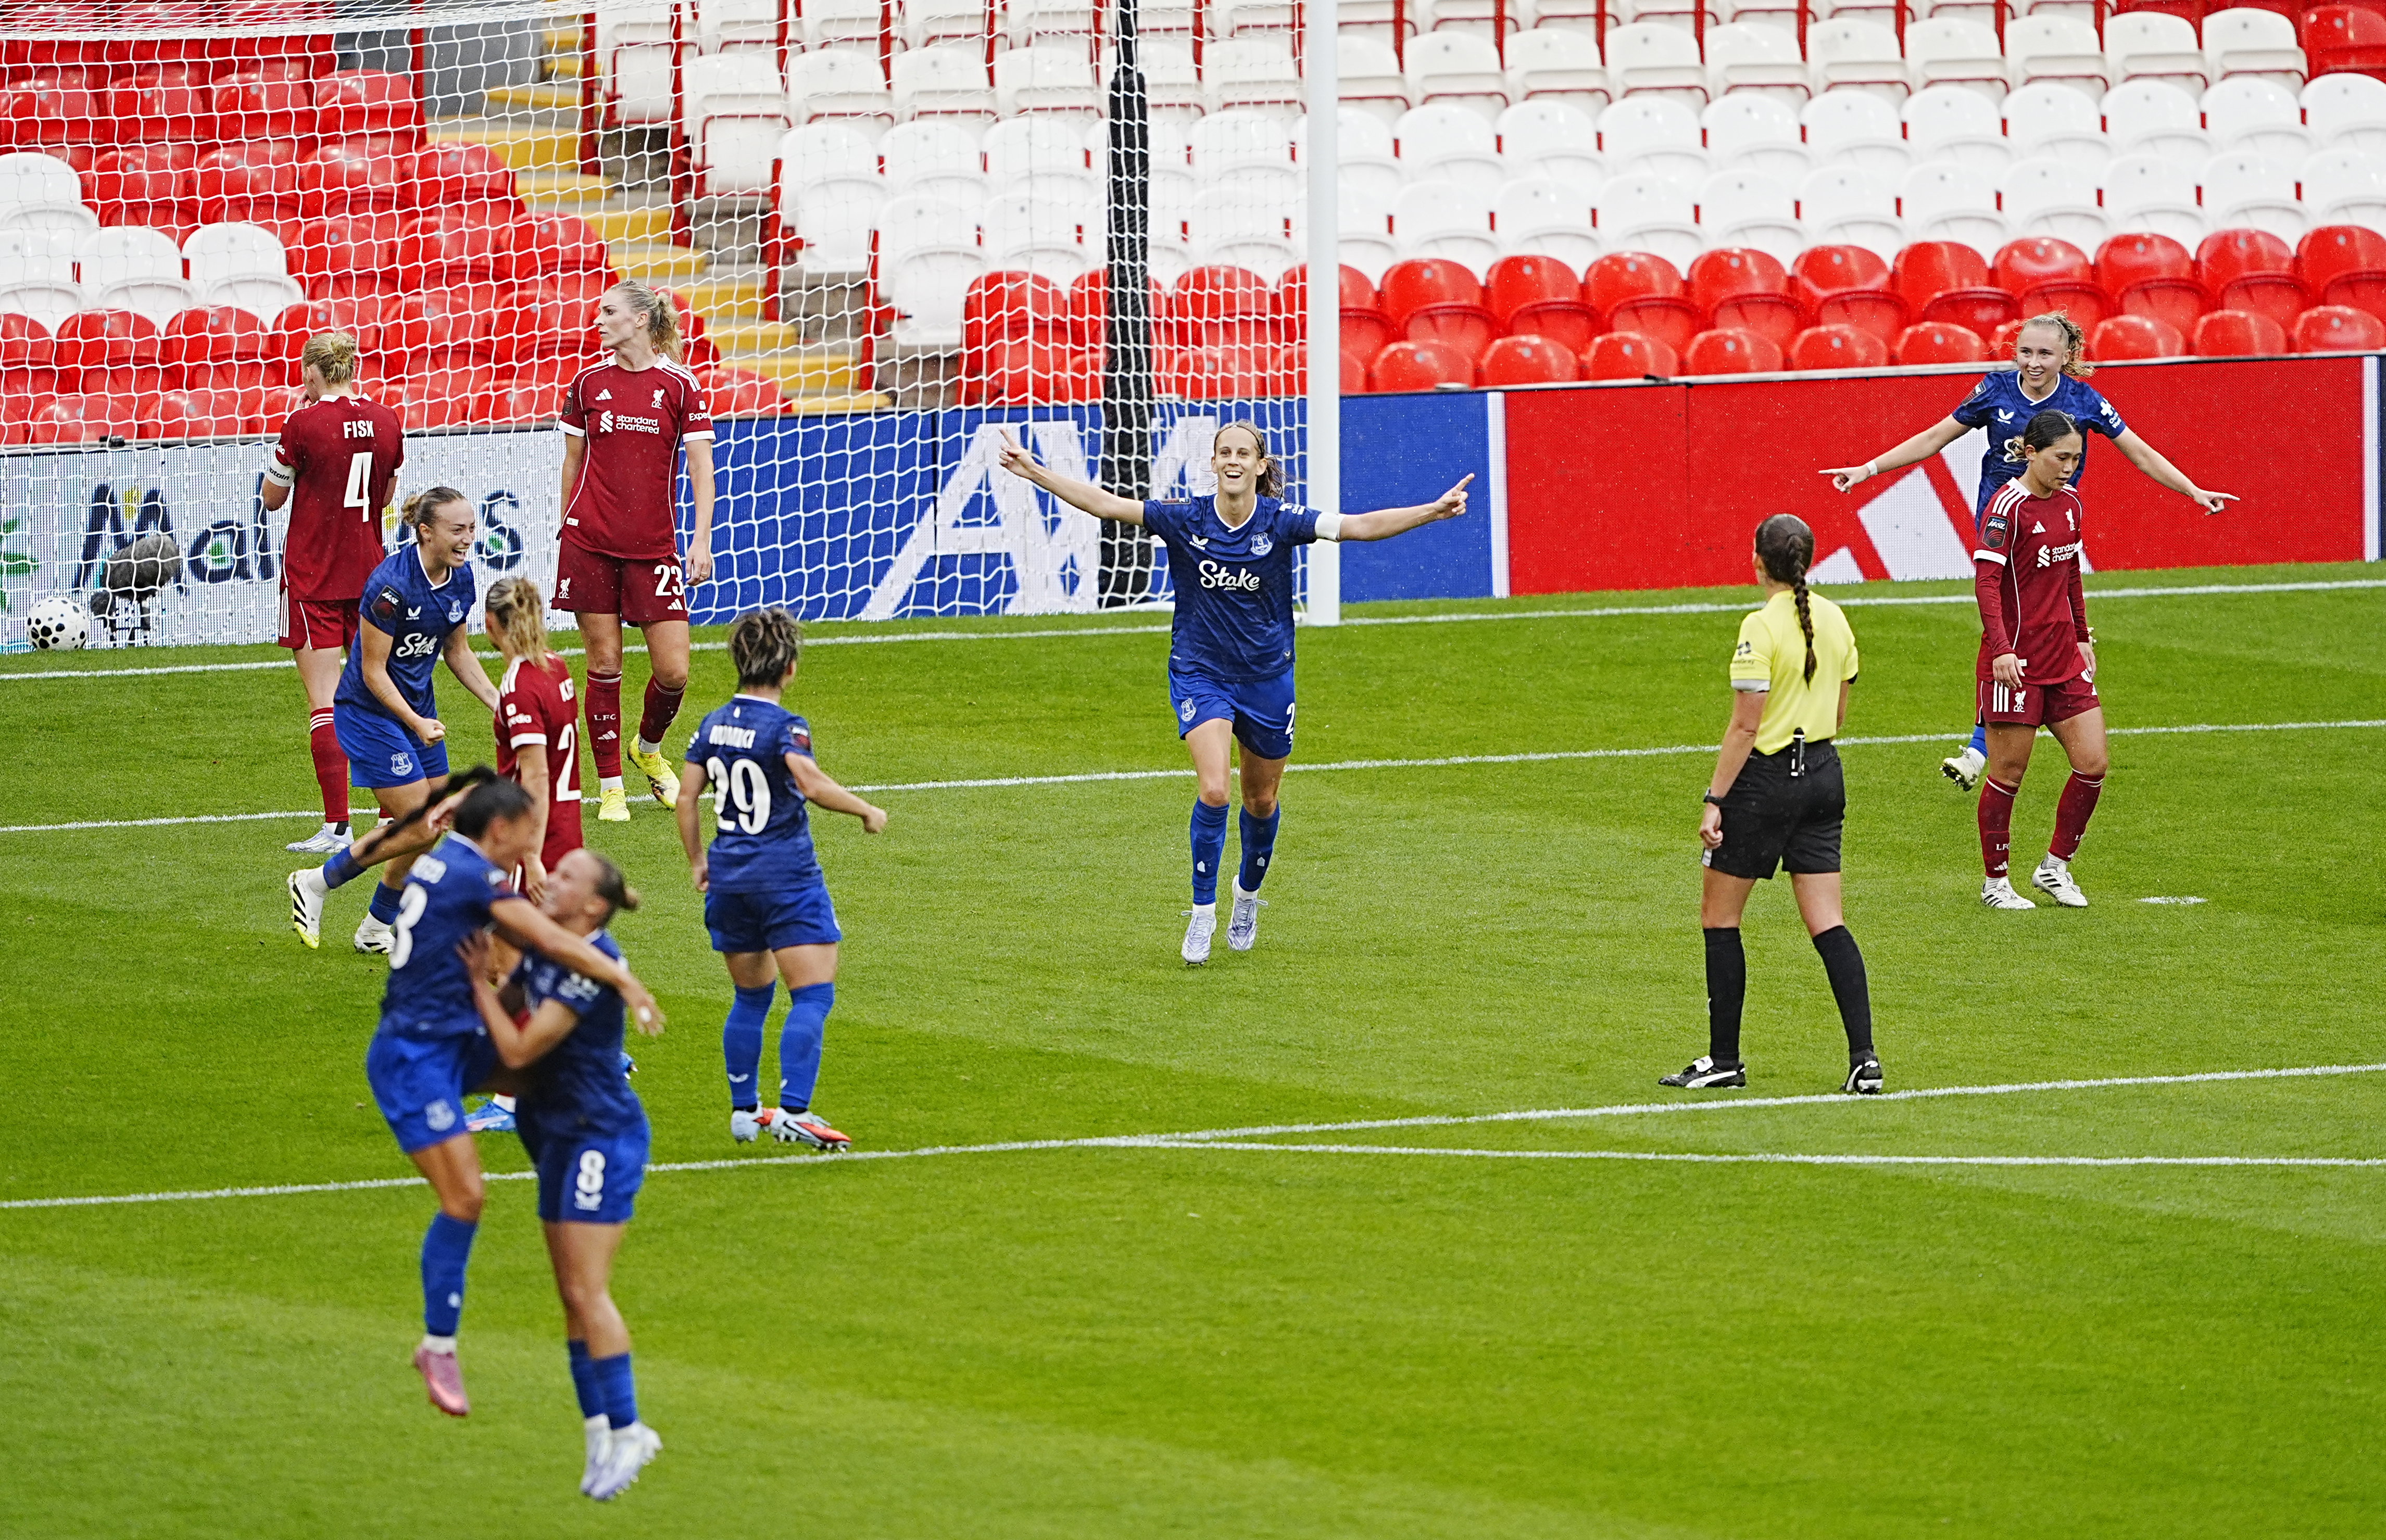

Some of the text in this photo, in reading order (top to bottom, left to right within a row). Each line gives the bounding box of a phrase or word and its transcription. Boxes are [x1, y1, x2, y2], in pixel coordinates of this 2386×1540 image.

[343, 420, 374, 439] FISK
[616, 414, 658, 426] standard
[616, 422, 660, 434] chartered
[344, 452, 373, 522] 4
[654, 564, 684, 596] 23
[1198, 560, 1260, 591] Stake
[556, 717, 582, 802] 2
[706, 756, 771, 835] 29
[576, 1150, 606, 1194] 8
